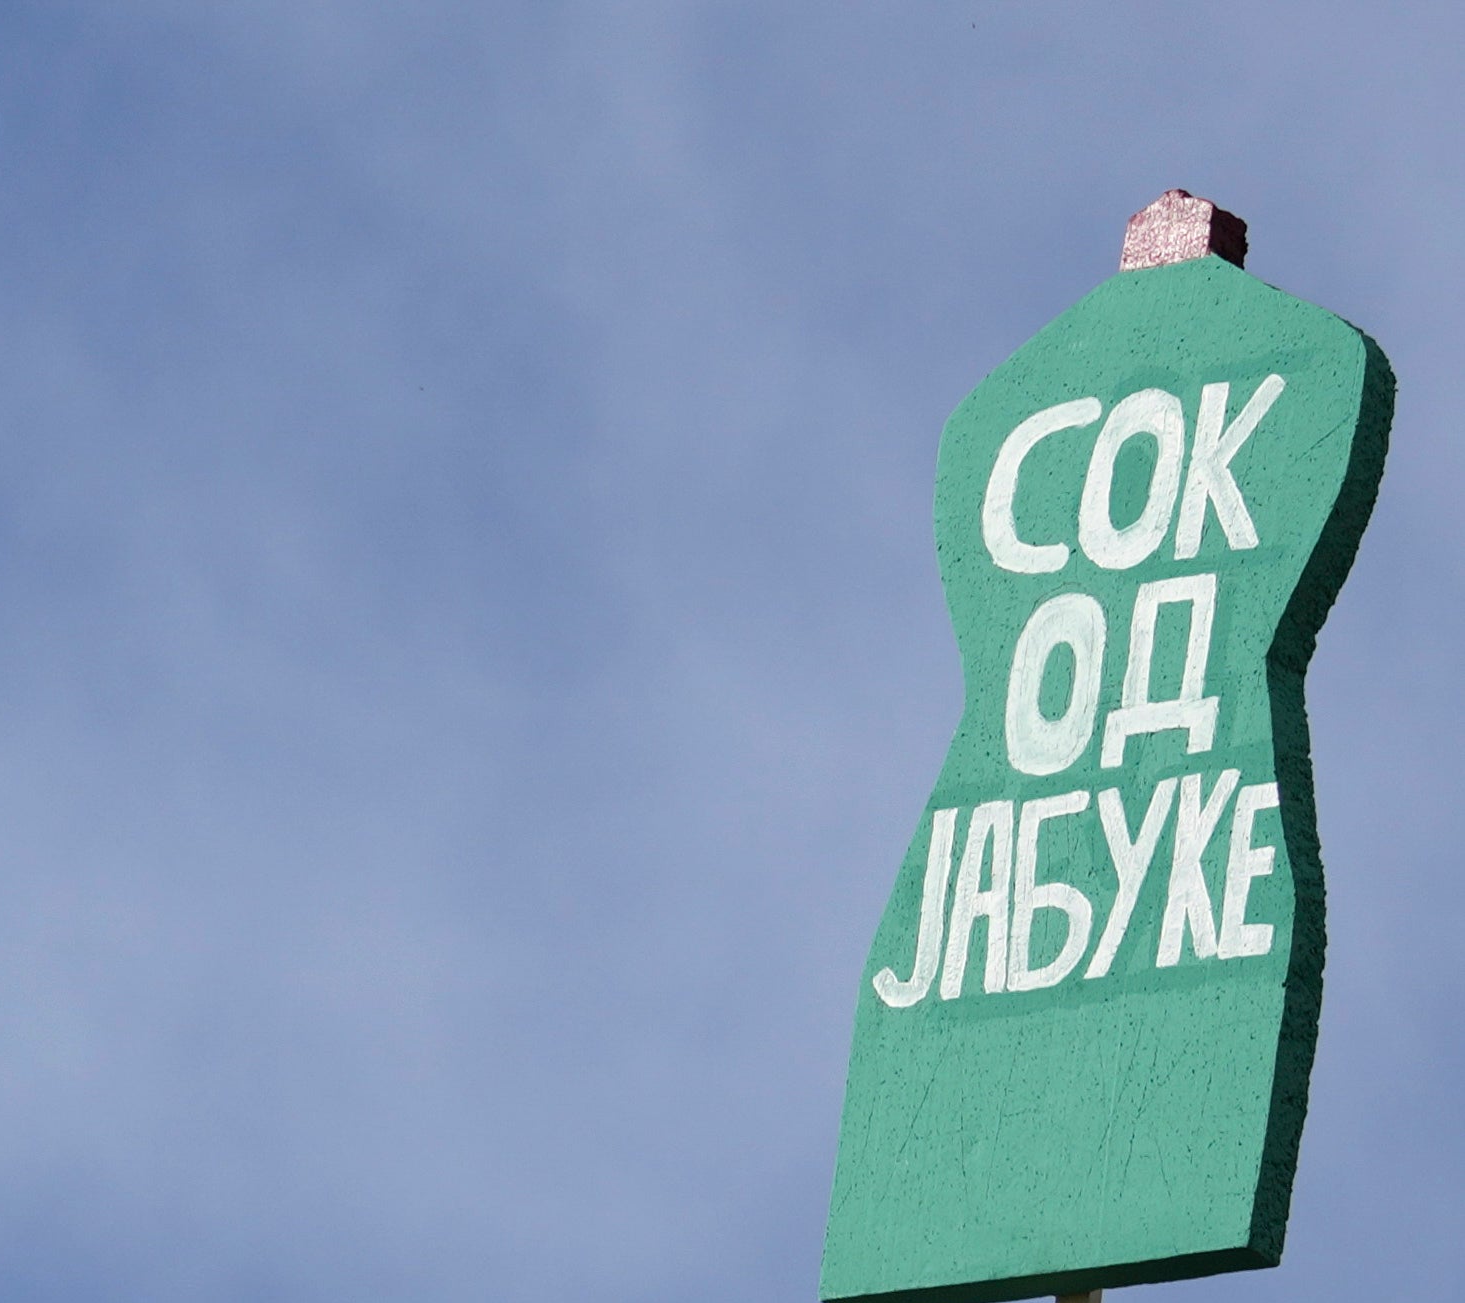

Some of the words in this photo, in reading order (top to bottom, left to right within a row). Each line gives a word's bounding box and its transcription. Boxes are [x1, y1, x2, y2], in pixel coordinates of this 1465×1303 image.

[982, 373, 1285, 575] СОК
[1004, 573, 1220, 776] ОД
[872, 767, 1282, 1008] ЈАБУКЕ
